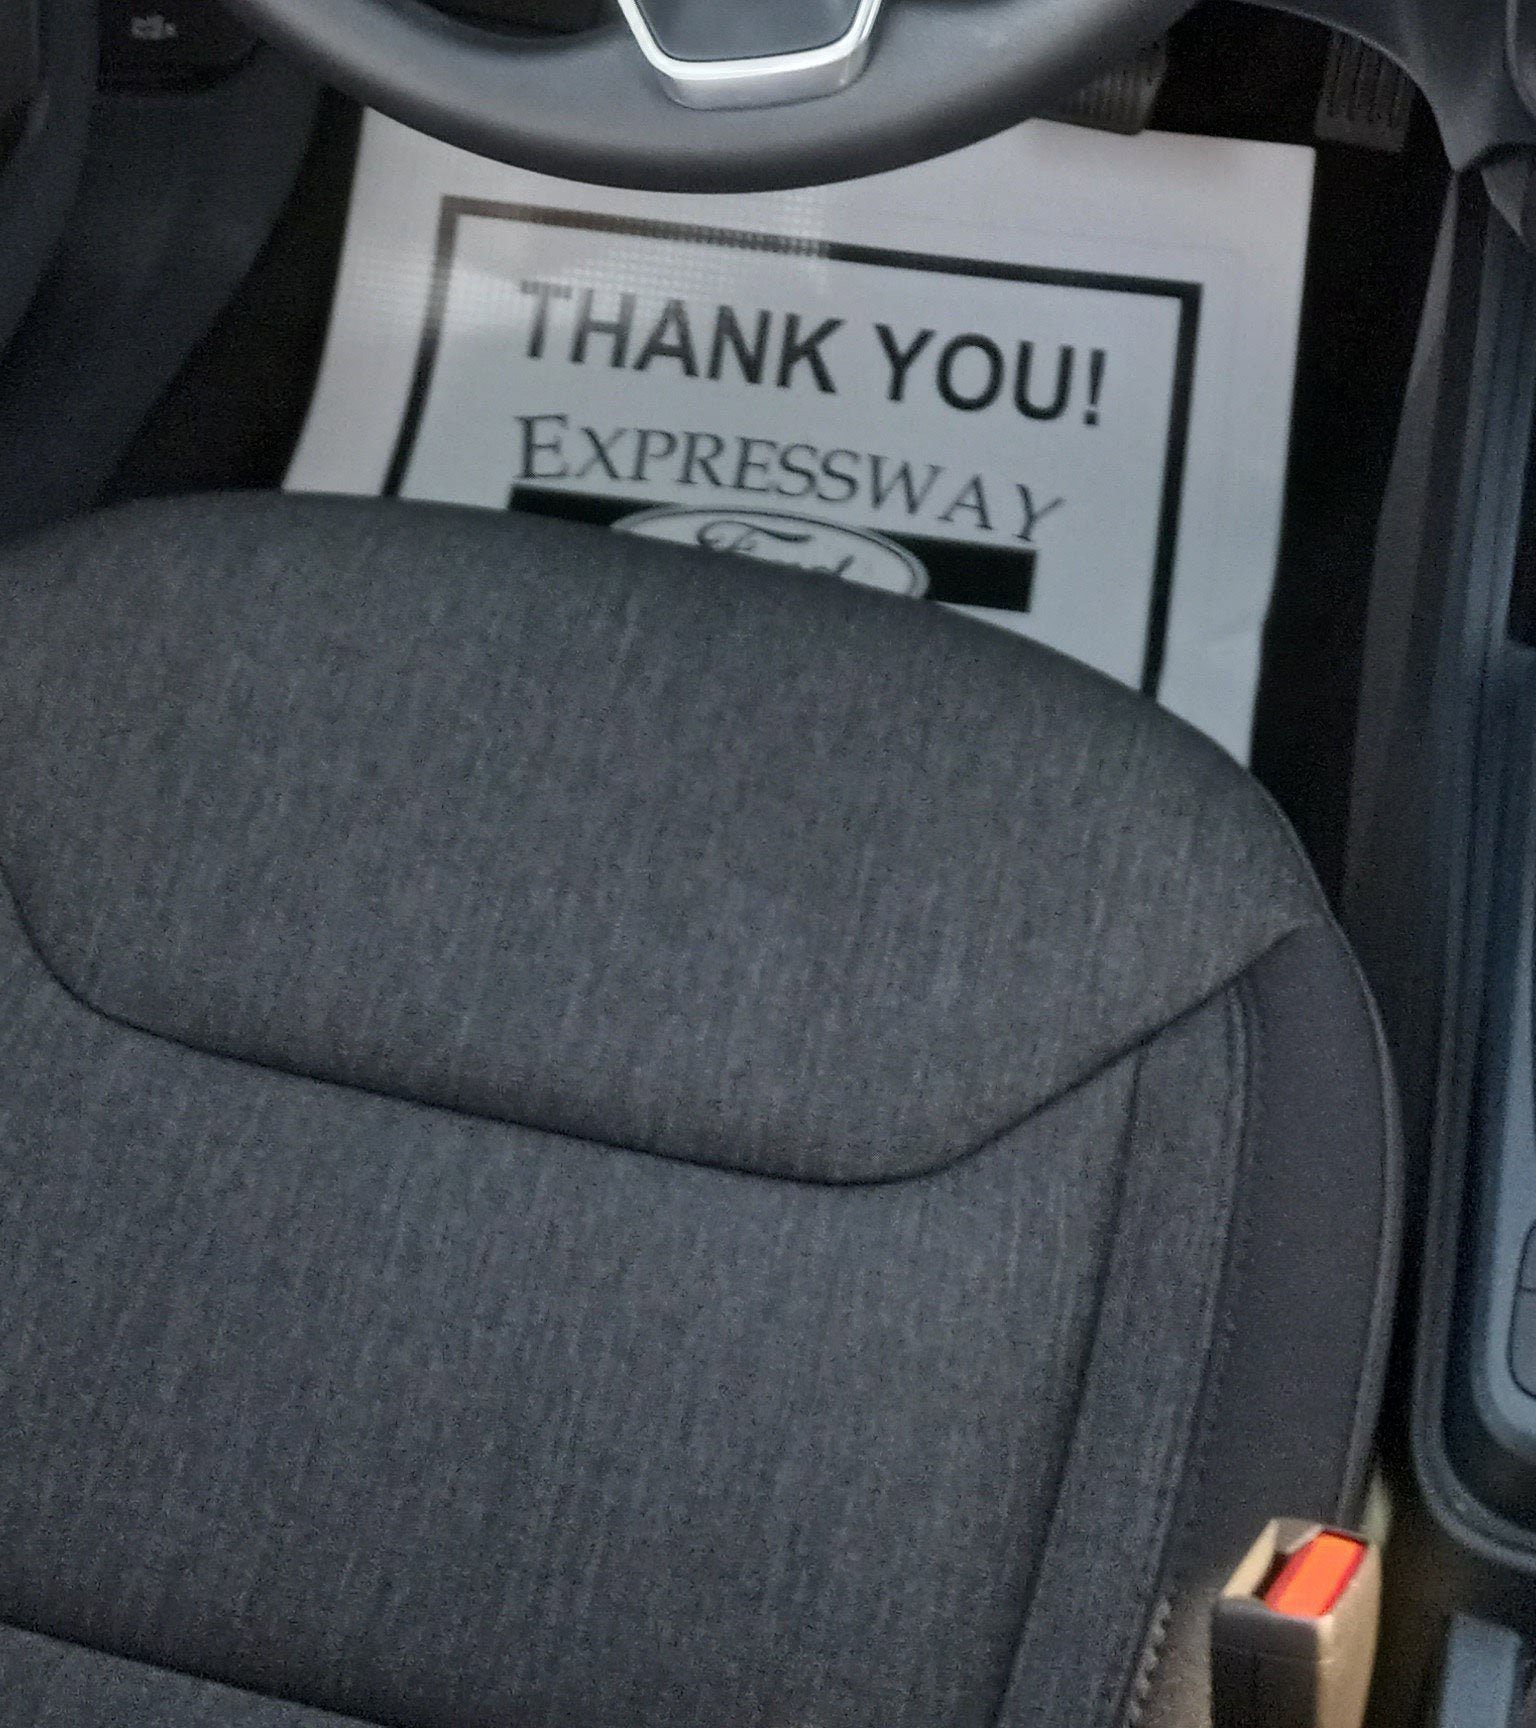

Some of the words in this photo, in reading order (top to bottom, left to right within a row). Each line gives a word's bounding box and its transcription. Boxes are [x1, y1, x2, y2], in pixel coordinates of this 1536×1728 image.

[520, 279, 847, 395] THANK
[873, 322, 1107, 427] YOU!
[514, 413, 1064, 543] EXPRESSWAY
